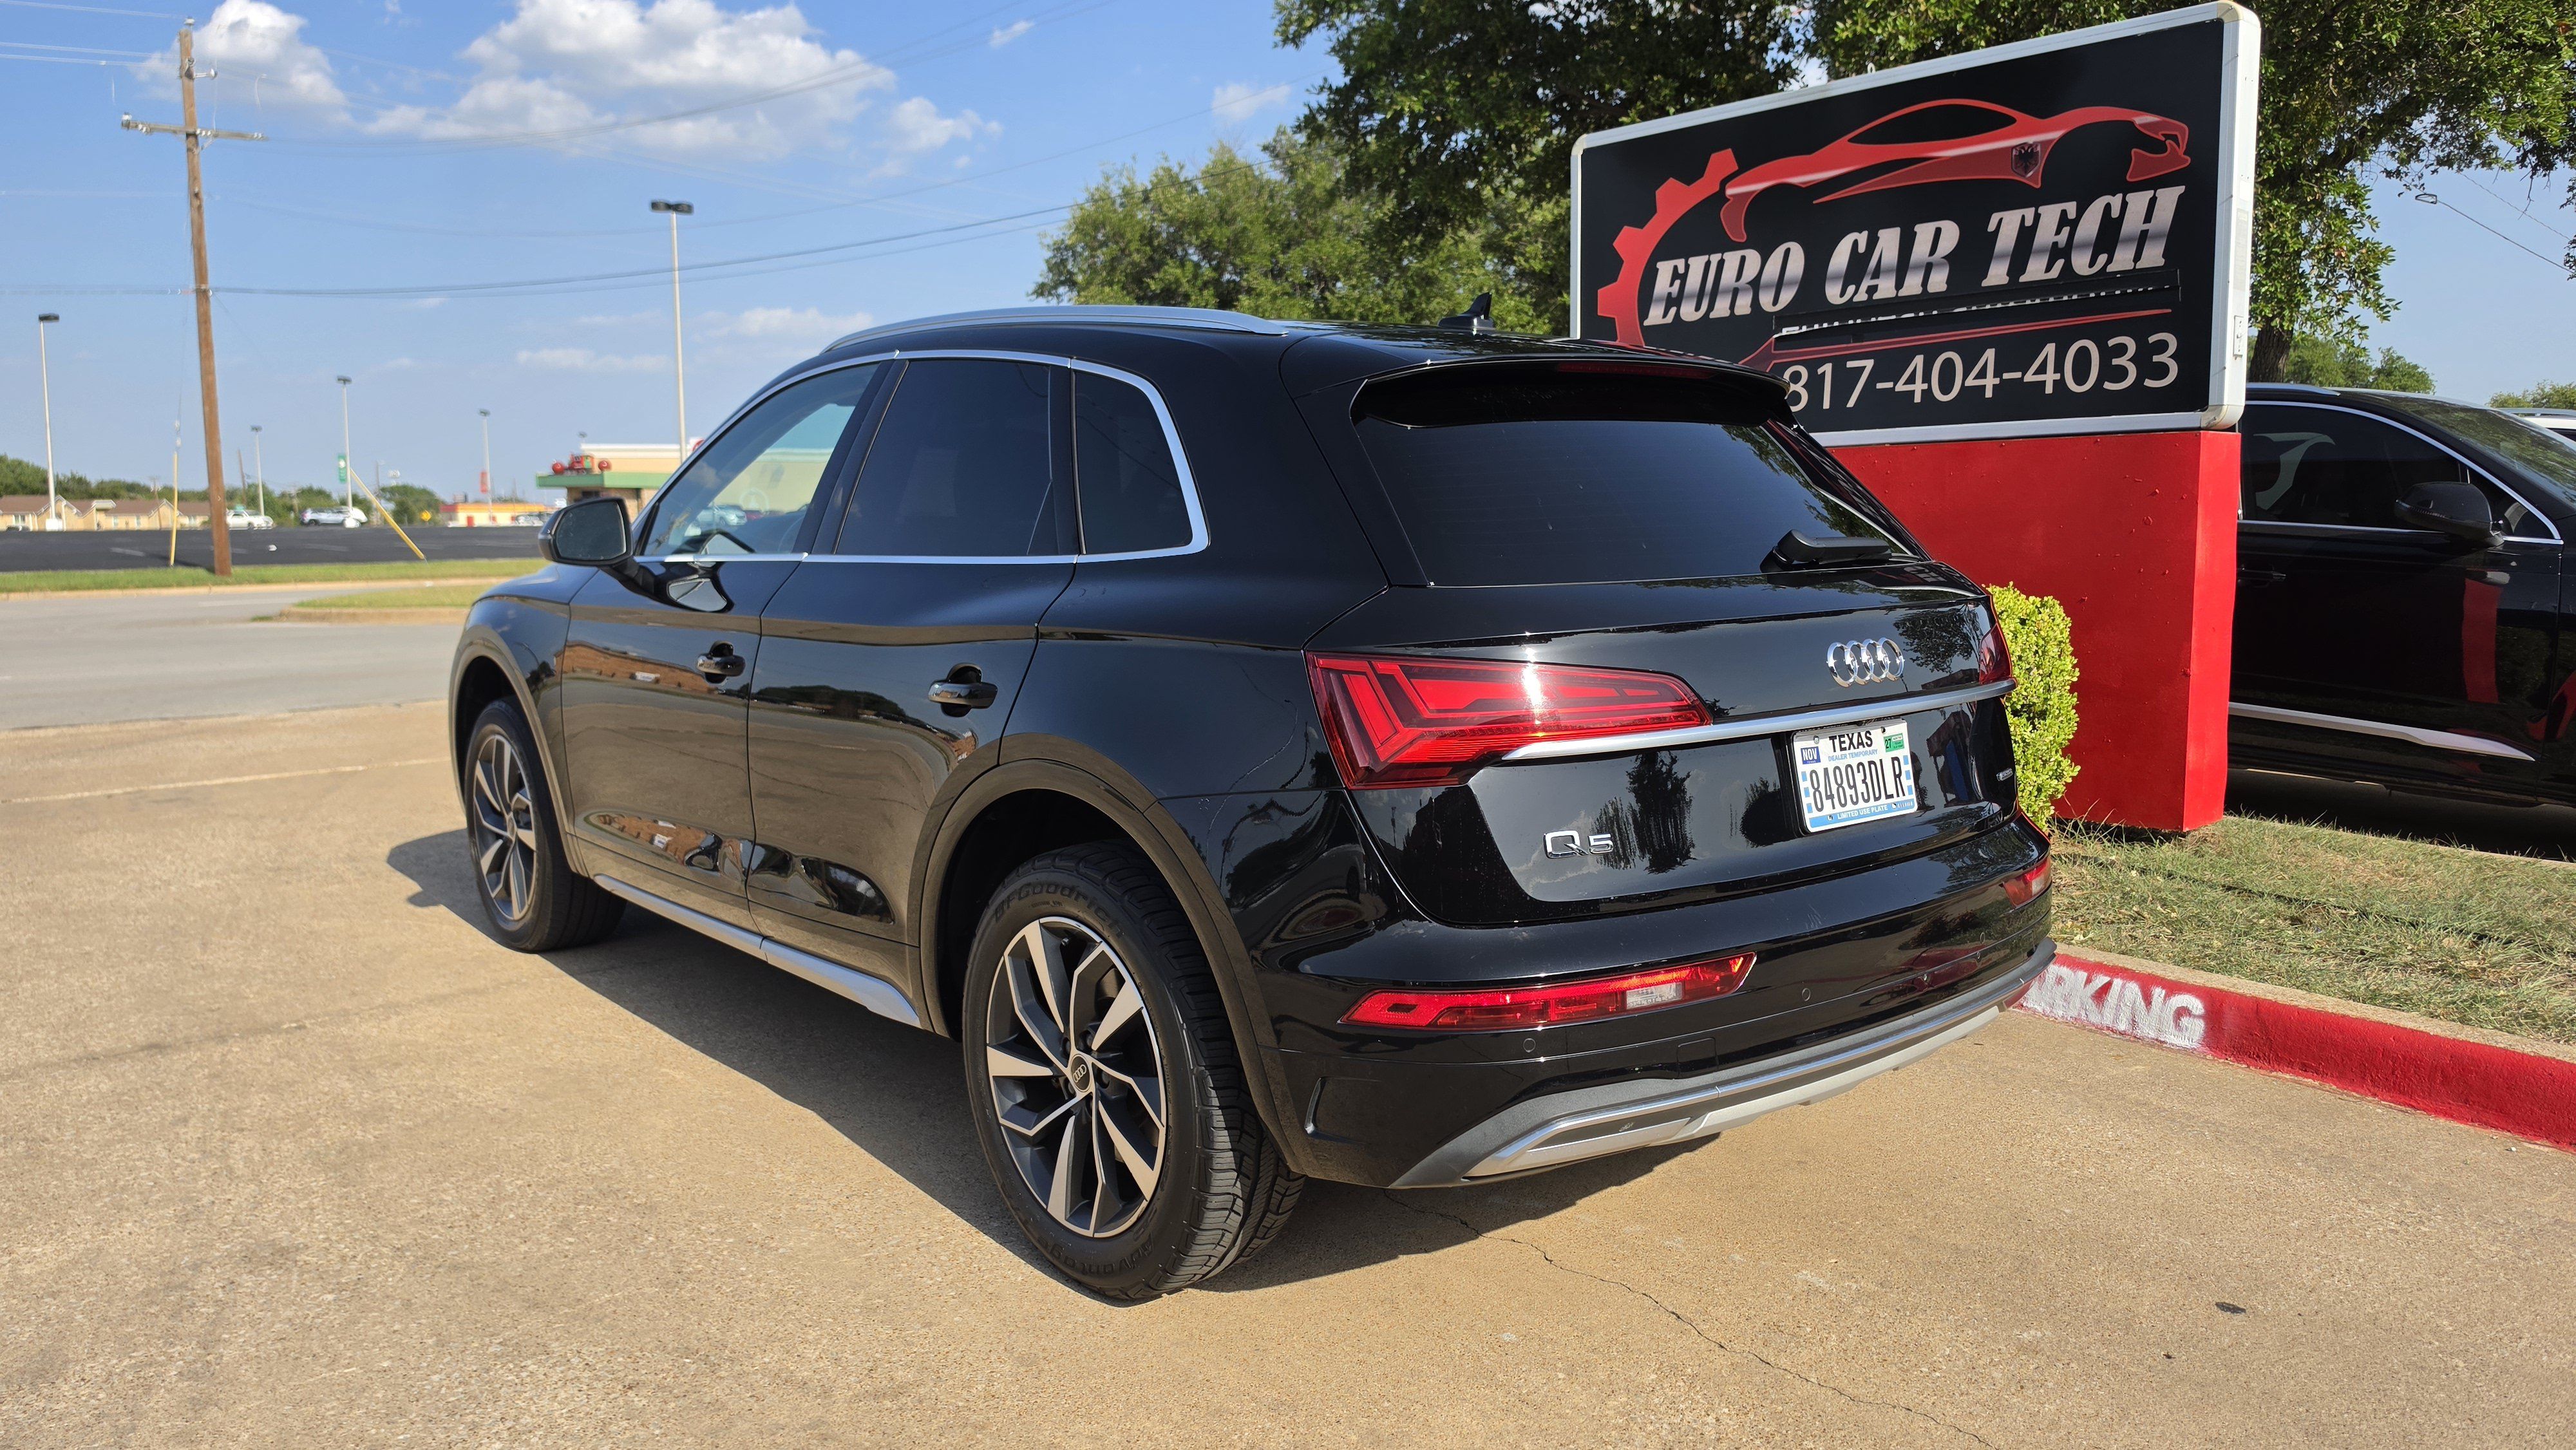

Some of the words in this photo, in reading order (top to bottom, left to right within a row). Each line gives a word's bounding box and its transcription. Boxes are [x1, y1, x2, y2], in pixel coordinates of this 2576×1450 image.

[1643, 241, 1804, 326] EURO
[1824, 220, 1960, 305] CAR
[1981, 185, 2186, 287] TECH
[1785, 332, 2179, 413] 817-404-4033
[1803, 748, 1817, 760] NOV
[1829, 731, 1873, 752] TEXAS
[1885, 739, 1891, 749] 27
[1828, 753, 1848, 762] DEALER
[1848, 749, 1878, 758] TEMPORARY
[1810, 756, 1906, 812] 84893DLR
[1837, 811, 1858, 820] LIMITED
[1871, 805, 1888, 813] PLATE
[1543, 830, 1614, 859] Q5
[2022, 965, 2206, 1048] RKING
